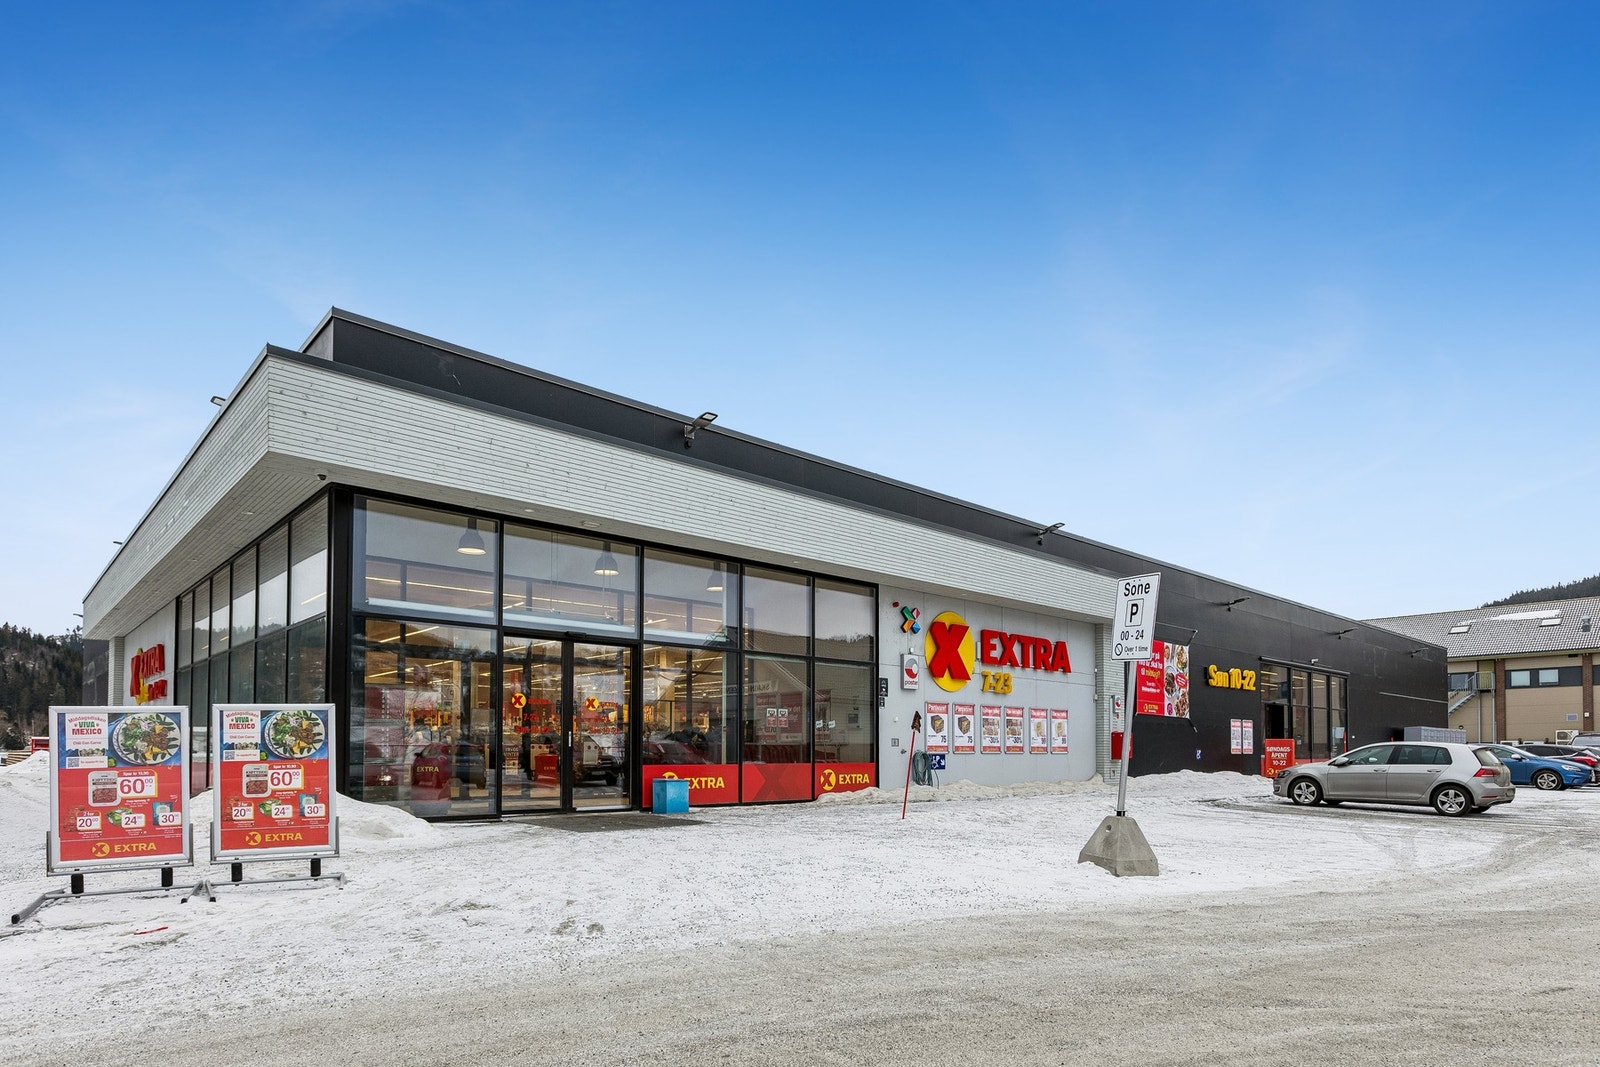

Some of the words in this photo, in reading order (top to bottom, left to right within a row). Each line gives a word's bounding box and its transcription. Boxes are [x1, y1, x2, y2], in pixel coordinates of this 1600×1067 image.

[1123, 582, 1151, 597] Sone
[1129, 603, 1139, 623] P
[1120, 630, 1130, 641] 00
[1135, 629, 1144, 640] 24
[980, 629, 1072, 674] EXTRA
[981, 670, 1014, 695] 7-23
[1229, 668, 1257, 691] 10-22
[270, 771, 293, 787] 60
[839, 773, 870, 785] EXTRA
[120, 778, 145, 795] 60
[234, 809, 246, 817] 20
[274, 808, 286, 816] 24
[307, 806, 319, 814] 30
[78, 818, 92, 827] 20
[124, 816, 137, 826] 24
[161, 814, 174, 823] 30
[265, 832, 303, 842] EXTRA
[114, 843, 157, 853] EXTRA
